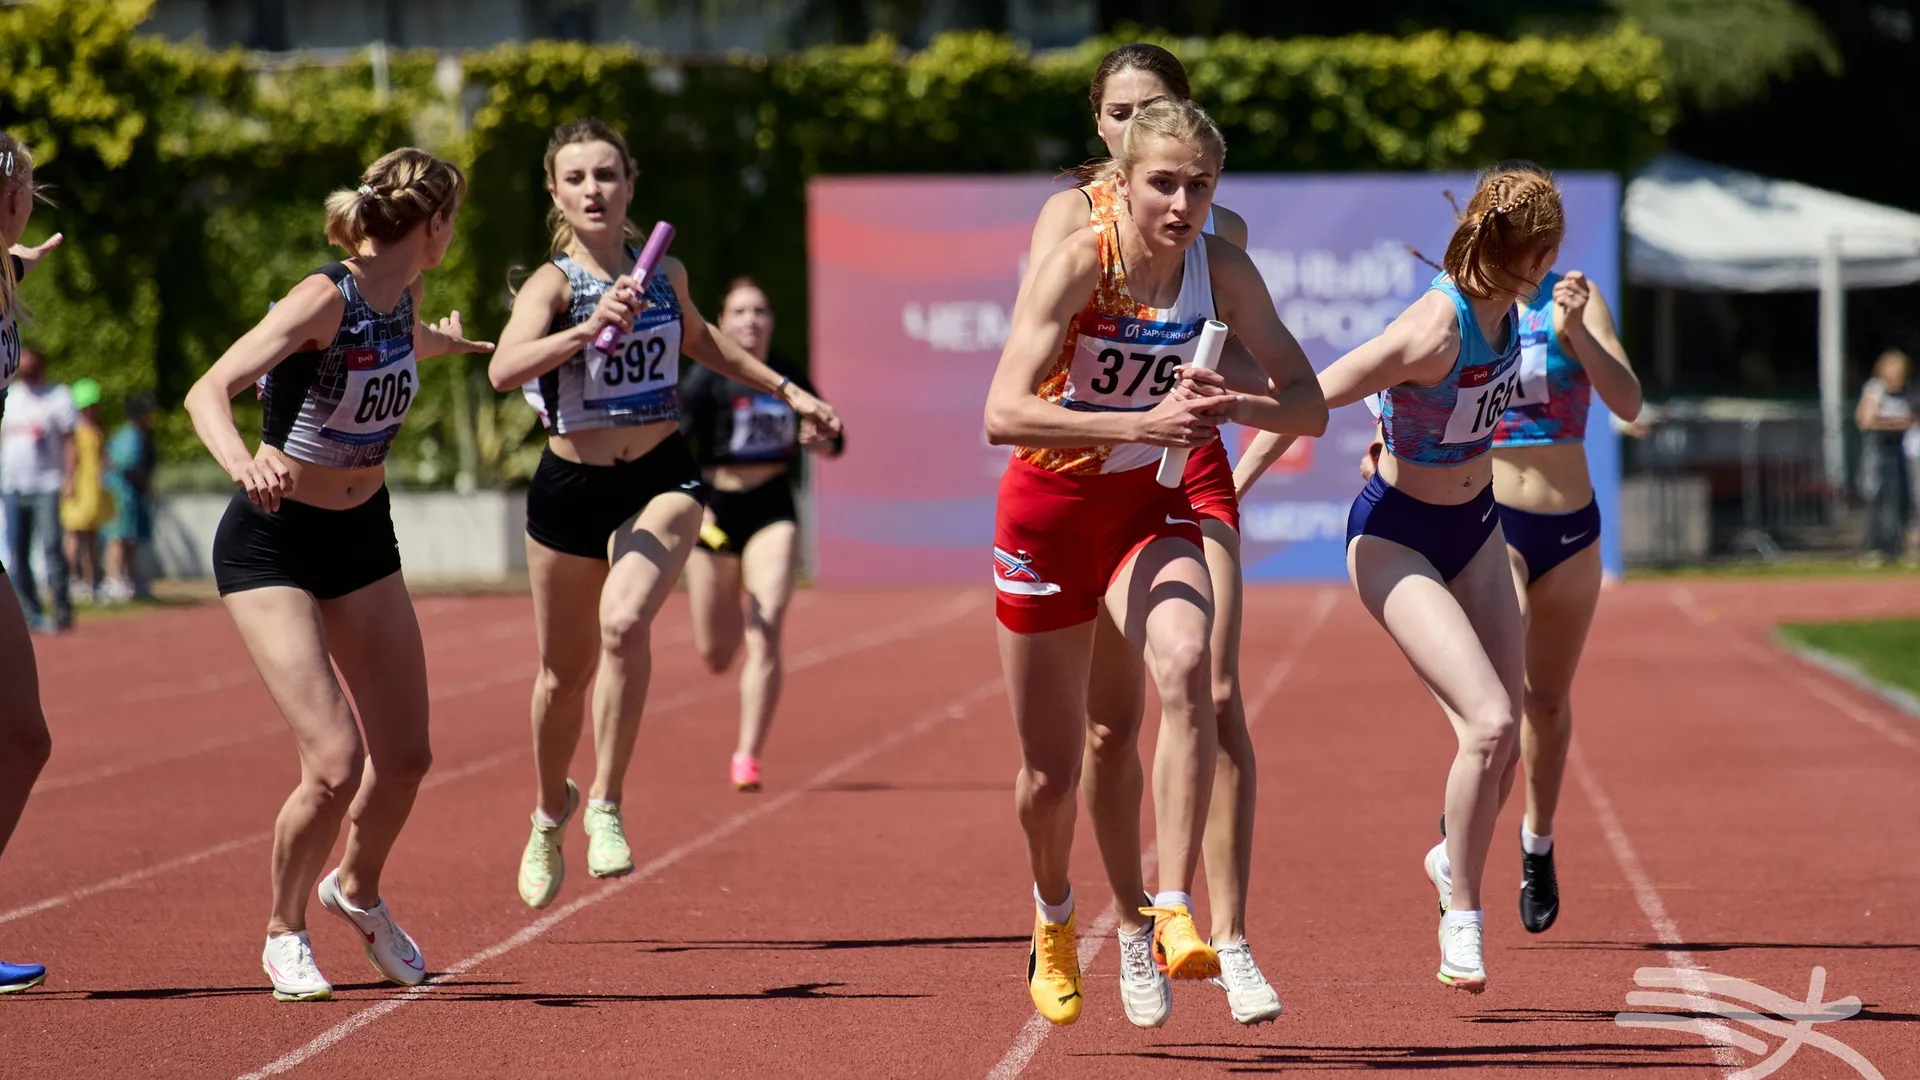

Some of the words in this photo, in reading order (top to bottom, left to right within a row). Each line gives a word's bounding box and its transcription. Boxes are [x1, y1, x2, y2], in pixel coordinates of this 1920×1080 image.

[603, 336, 667, 386] 592
[1091, 348, 1182, 397] 379
[354, 369, 412, 424] 606
